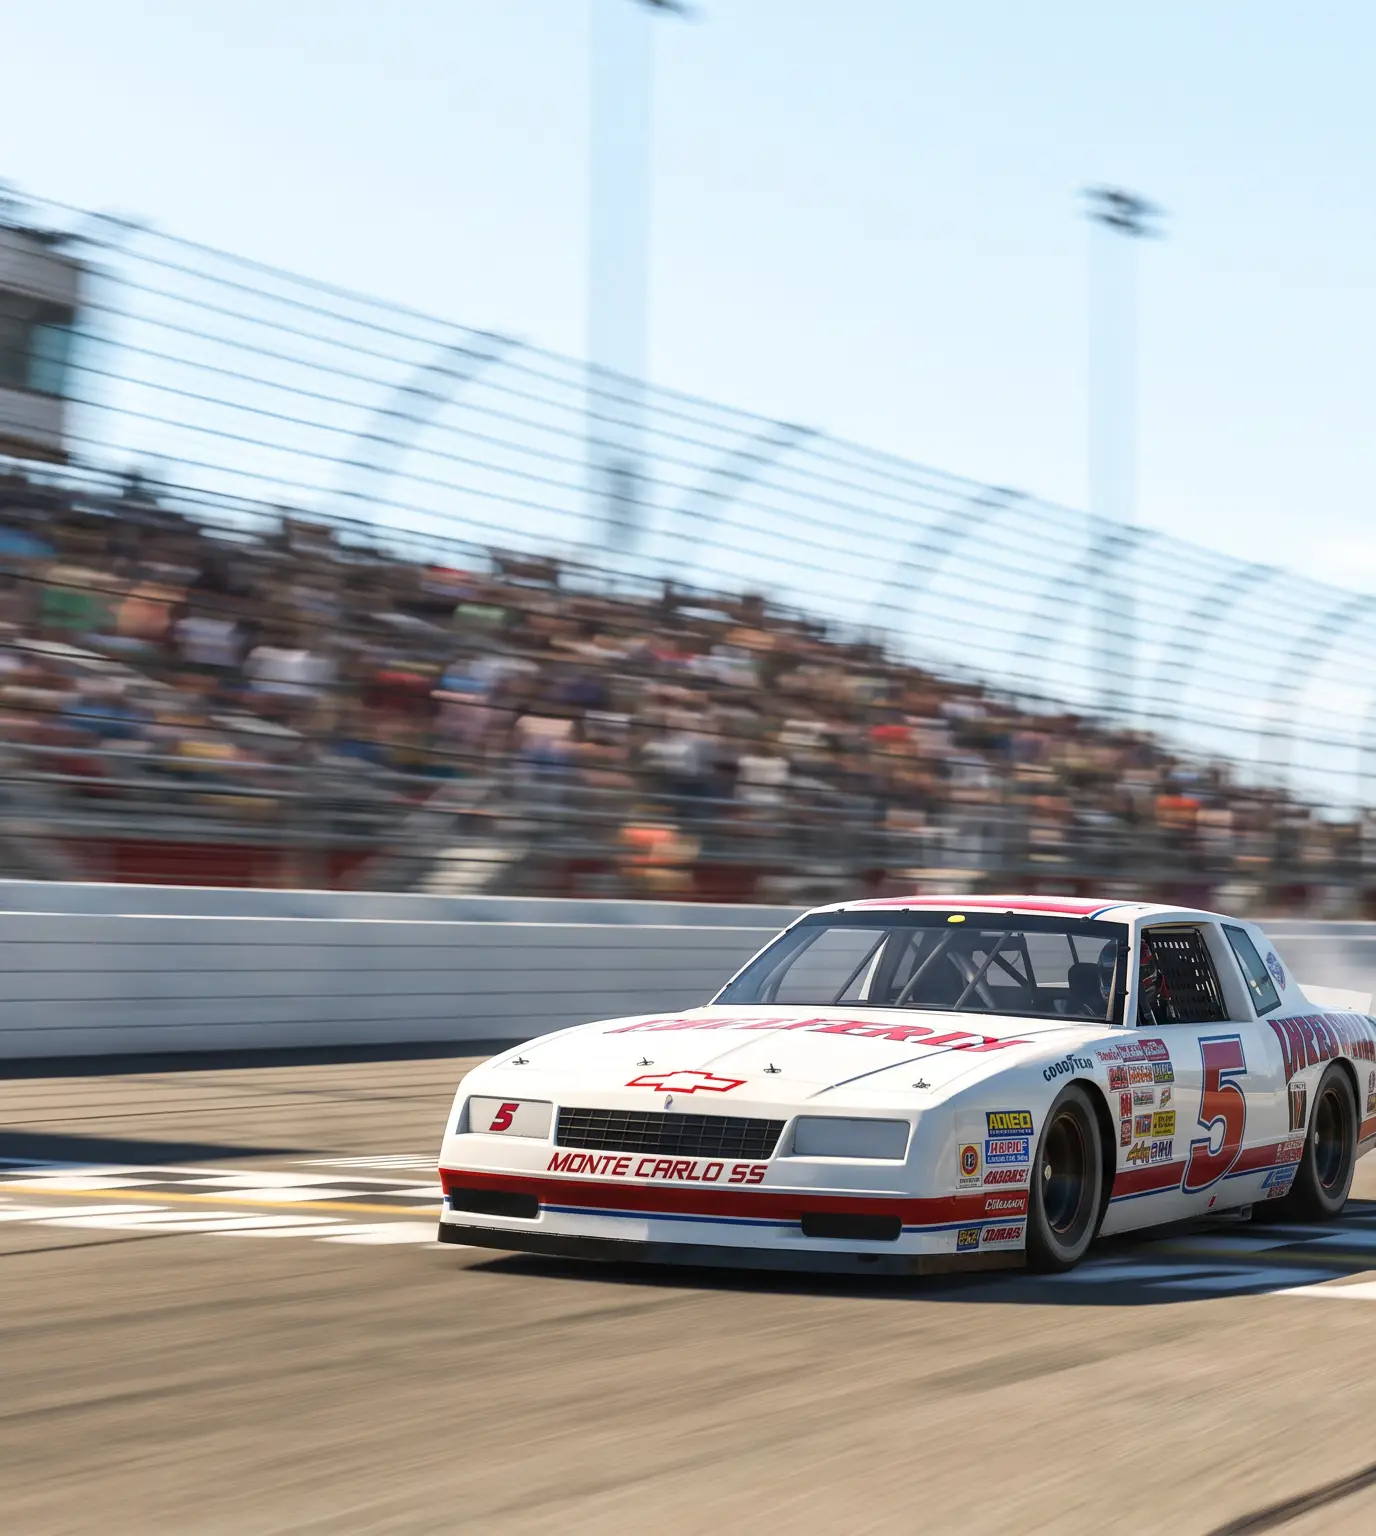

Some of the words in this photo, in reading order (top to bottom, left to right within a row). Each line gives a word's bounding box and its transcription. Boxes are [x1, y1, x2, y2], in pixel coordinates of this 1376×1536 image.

[489, 1103, 519, 1131] 5
[1181, 1033, 1248, 1194] 5
[547, 1152, 627, 1176] MONTE
[634, 1158, 724, 1182] CARLO
[728, 1164, 768, 1184] SS
